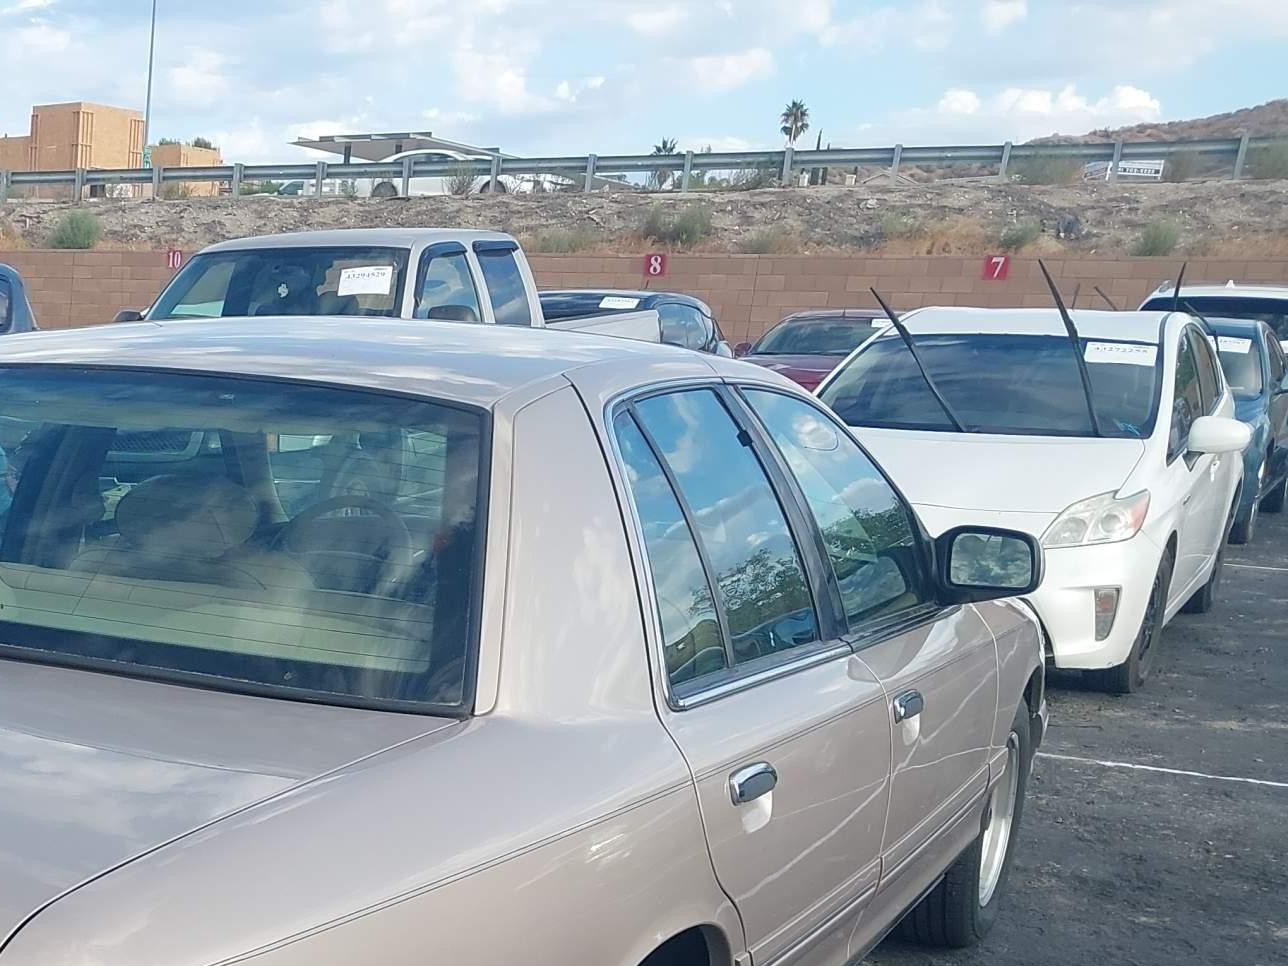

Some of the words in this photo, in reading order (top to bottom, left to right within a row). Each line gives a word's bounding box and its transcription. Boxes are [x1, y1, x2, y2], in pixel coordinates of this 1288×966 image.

[168, 251, 182, 268] 10
[649, 255, 662, 275] 8
[991, 256, 1006, 279] 7
